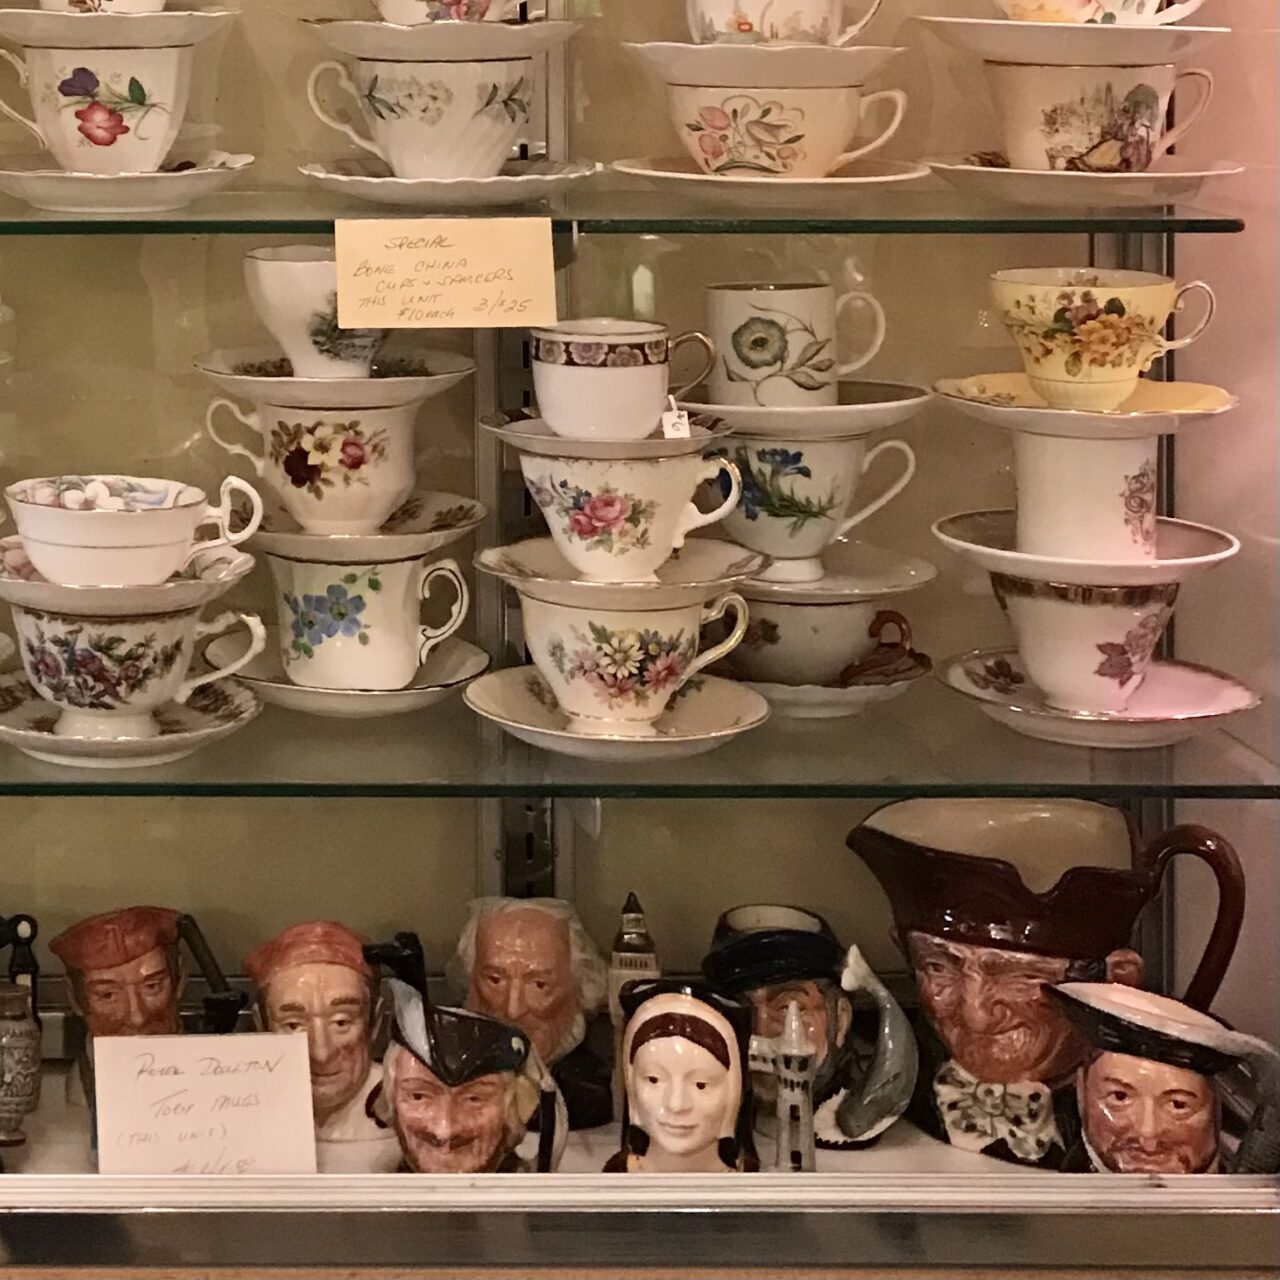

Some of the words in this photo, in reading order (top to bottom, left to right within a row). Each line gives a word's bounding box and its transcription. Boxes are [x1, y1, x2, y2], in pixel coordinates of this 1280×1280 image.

[384, 235, 456, 250] SPECIAL
[353, 259, 396, 277] BONE
[414, 258, 468, 273] CHINA
[375, 277, 417, 293] CUPS
[436, 269, 515, 287] SAUCERS
